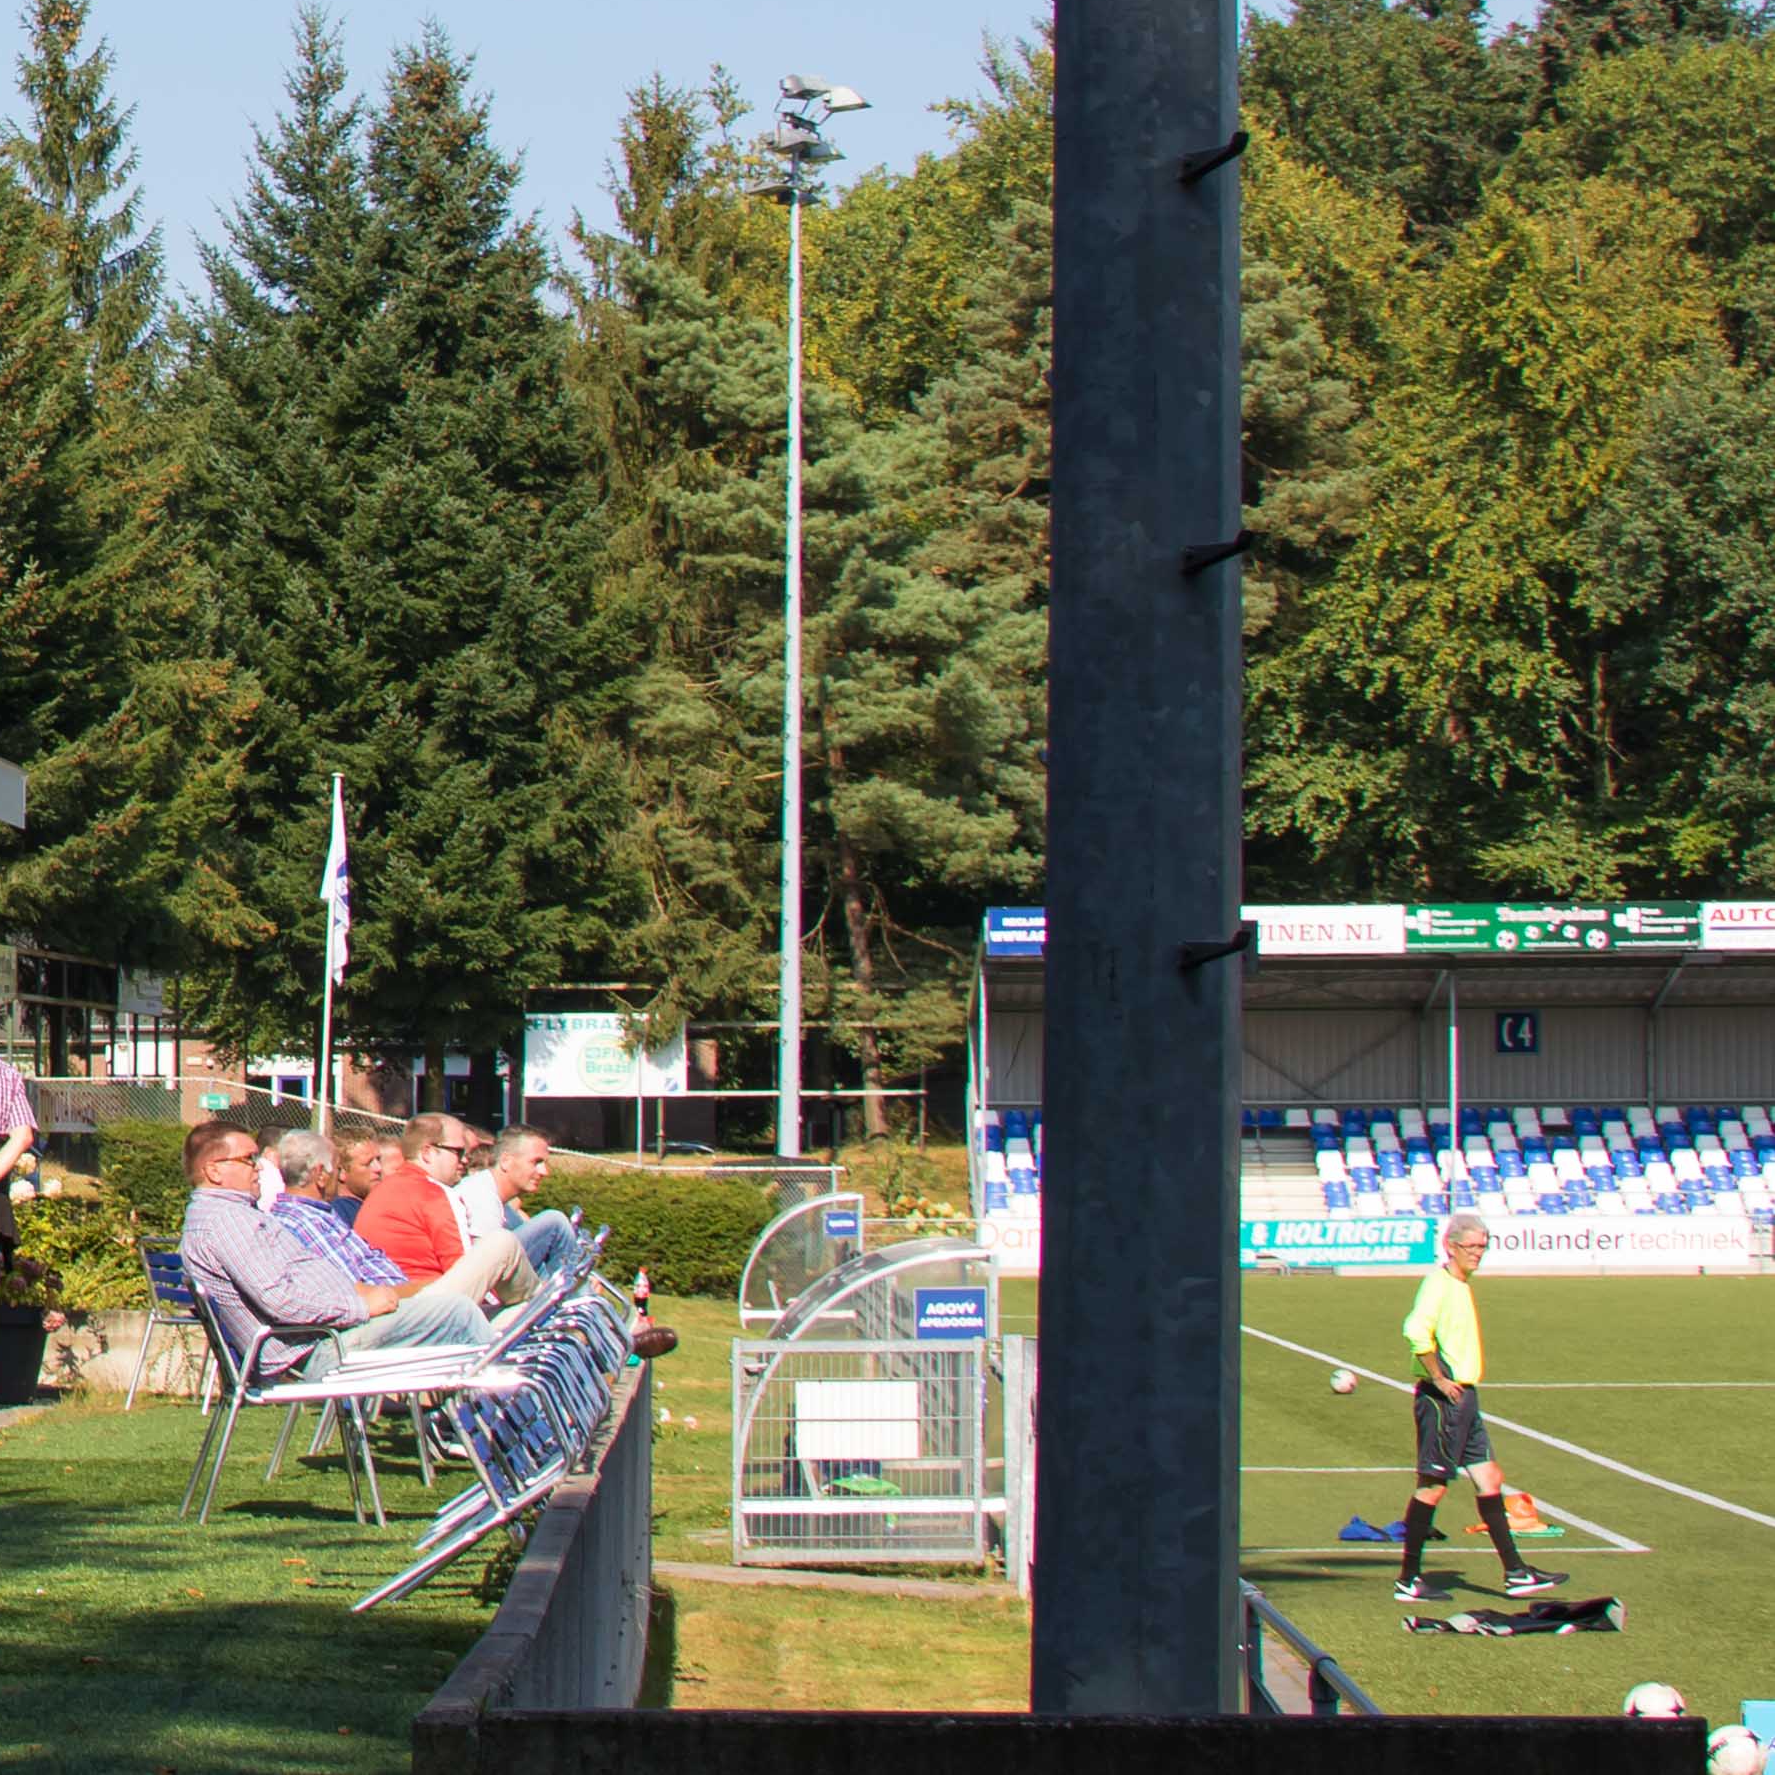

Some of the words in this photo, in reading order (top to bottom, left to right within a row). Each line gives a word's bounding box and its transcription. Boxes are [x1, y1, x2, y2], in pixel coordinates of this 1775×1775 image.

[1274, 1220, 1428, 1245] HOLTRIGTER
[1630, 1226, 1745, 1251] techniek
[926, 1302, 977, 1315] AGOVV
